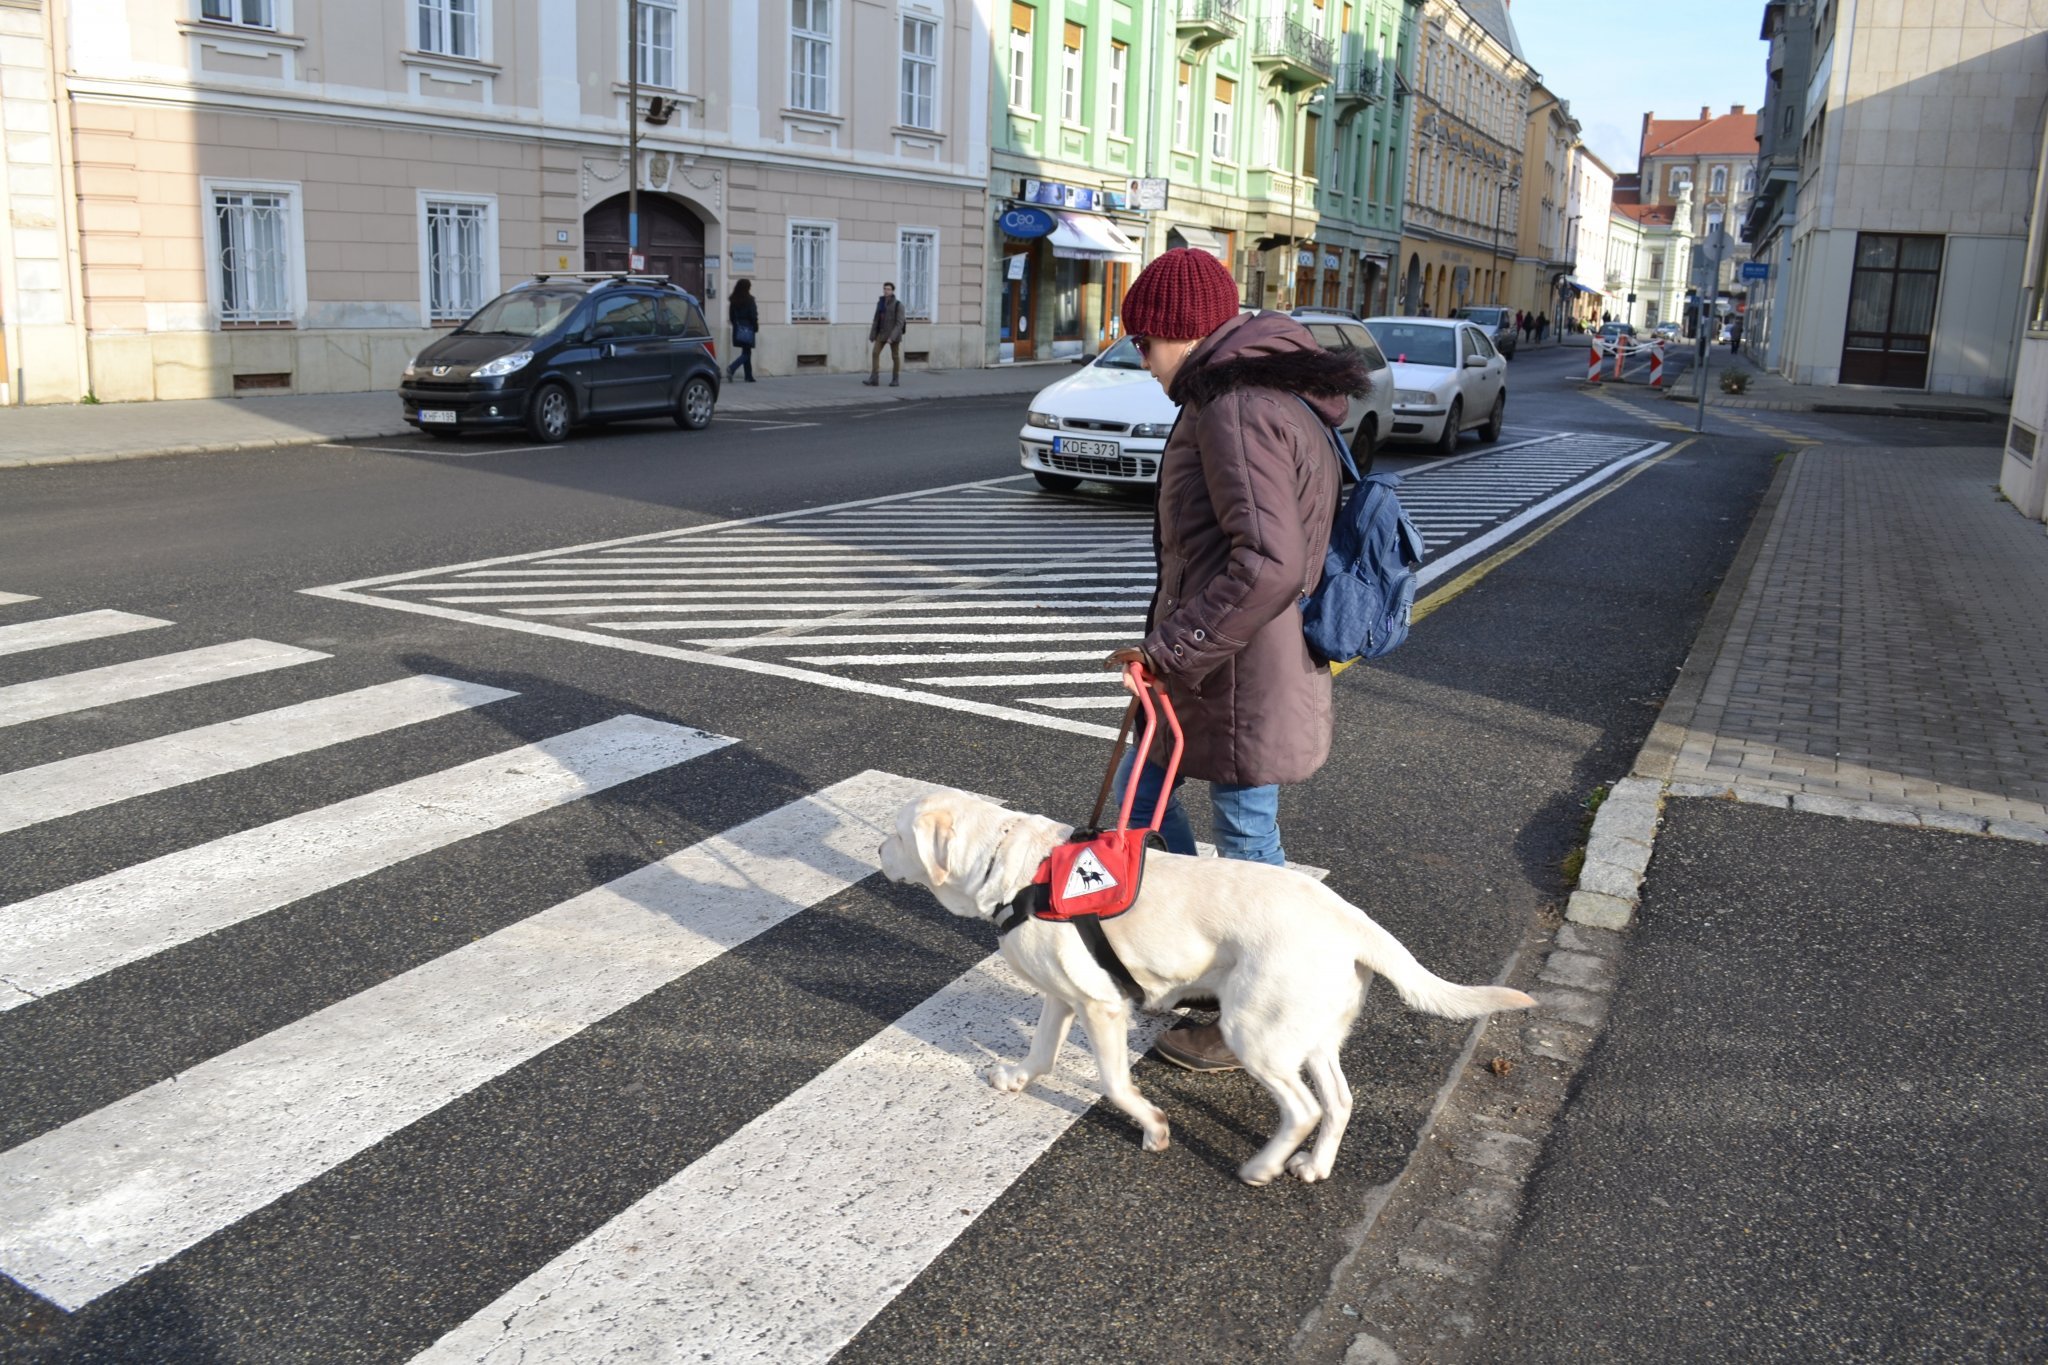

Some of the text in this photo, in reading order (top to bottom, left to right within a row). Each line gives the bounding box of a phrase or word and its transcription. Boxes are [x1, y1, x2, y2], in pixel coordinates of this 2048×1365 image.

[1005, 211, 1035, 227] Ceo
[423, 411, 455, 422] KHF-195
[1062, 440, 1115, 456] KDE-373
